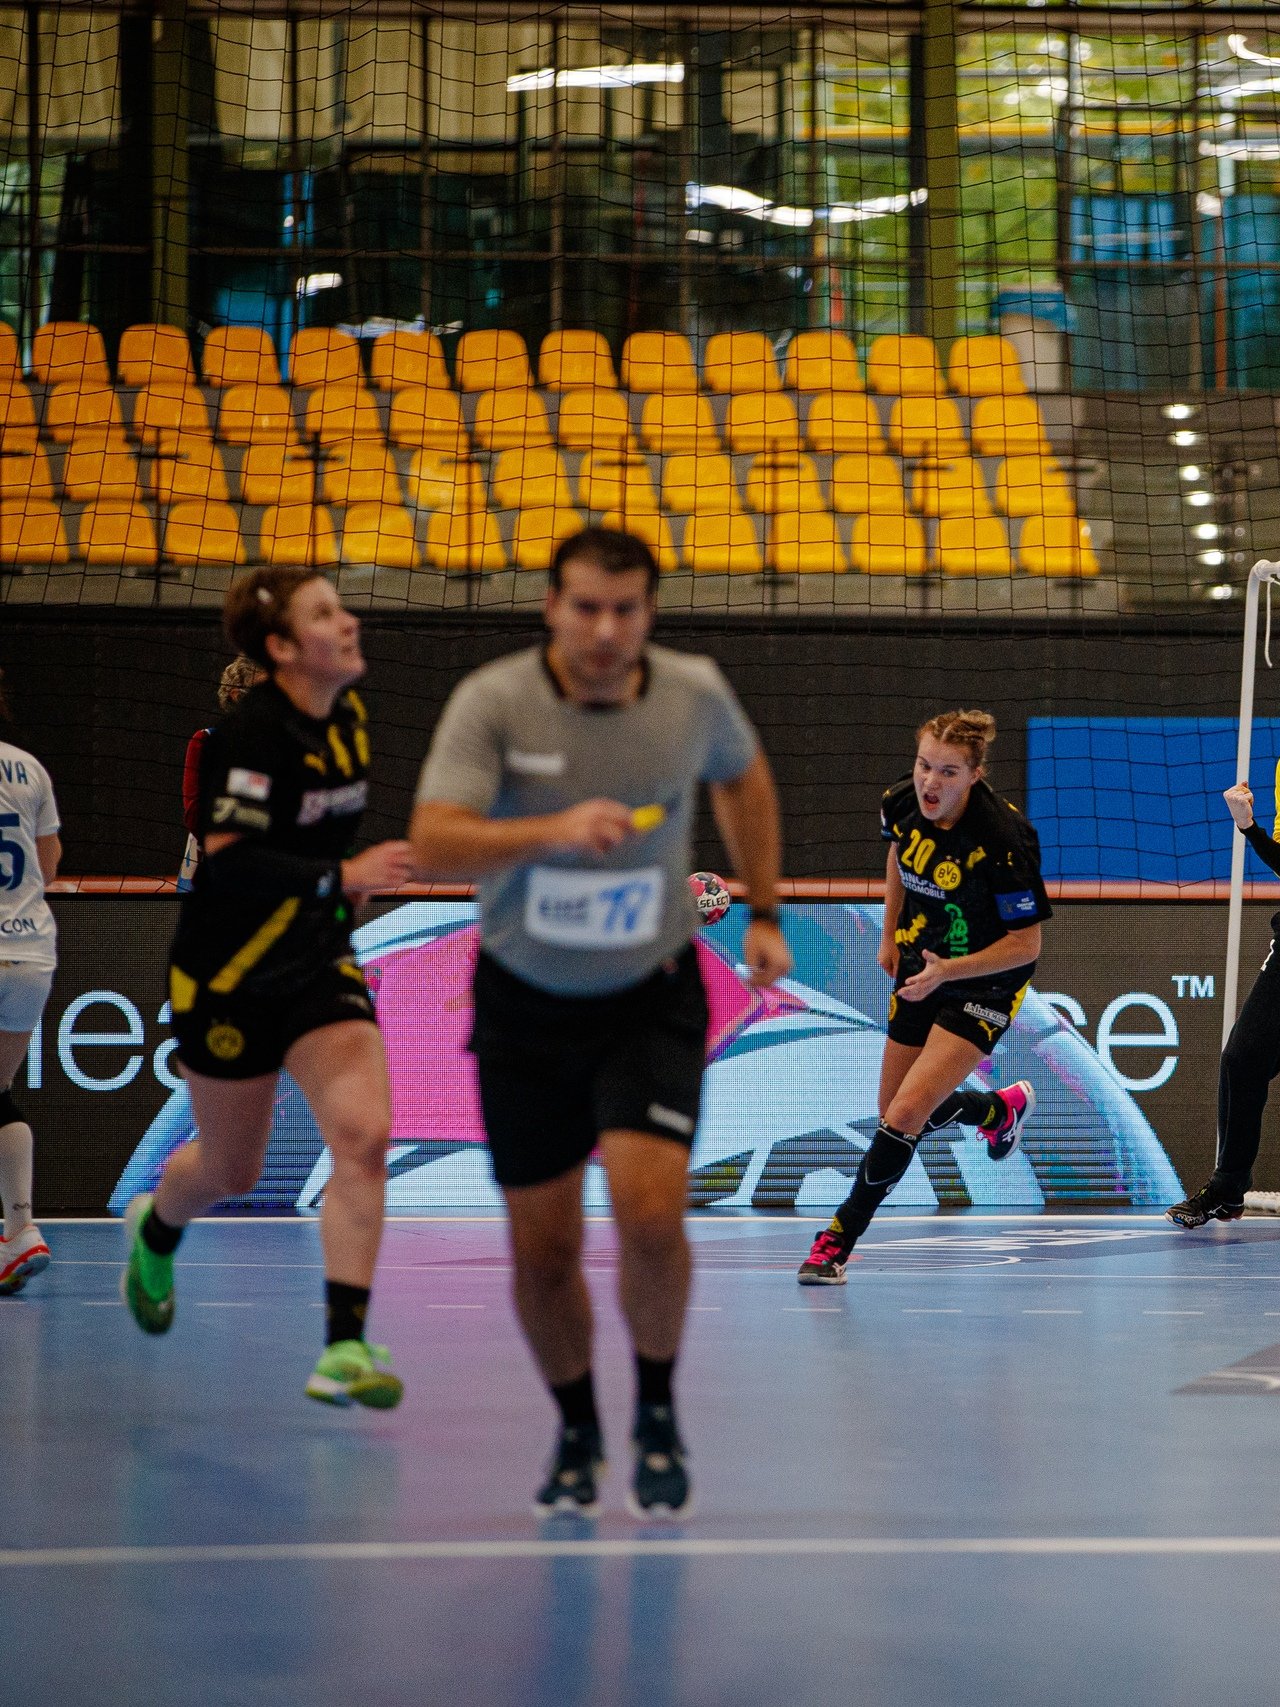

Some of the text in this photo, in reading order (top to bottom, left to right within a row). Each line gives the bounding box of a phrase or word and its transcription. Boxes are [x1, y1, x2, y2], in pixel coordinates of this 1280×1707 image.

[0, 759, 28, 786] VA
[901, 829, 936, 875] 20
[937, 863, 958, 884] BVB
[1, 917, 37, 935] CON
